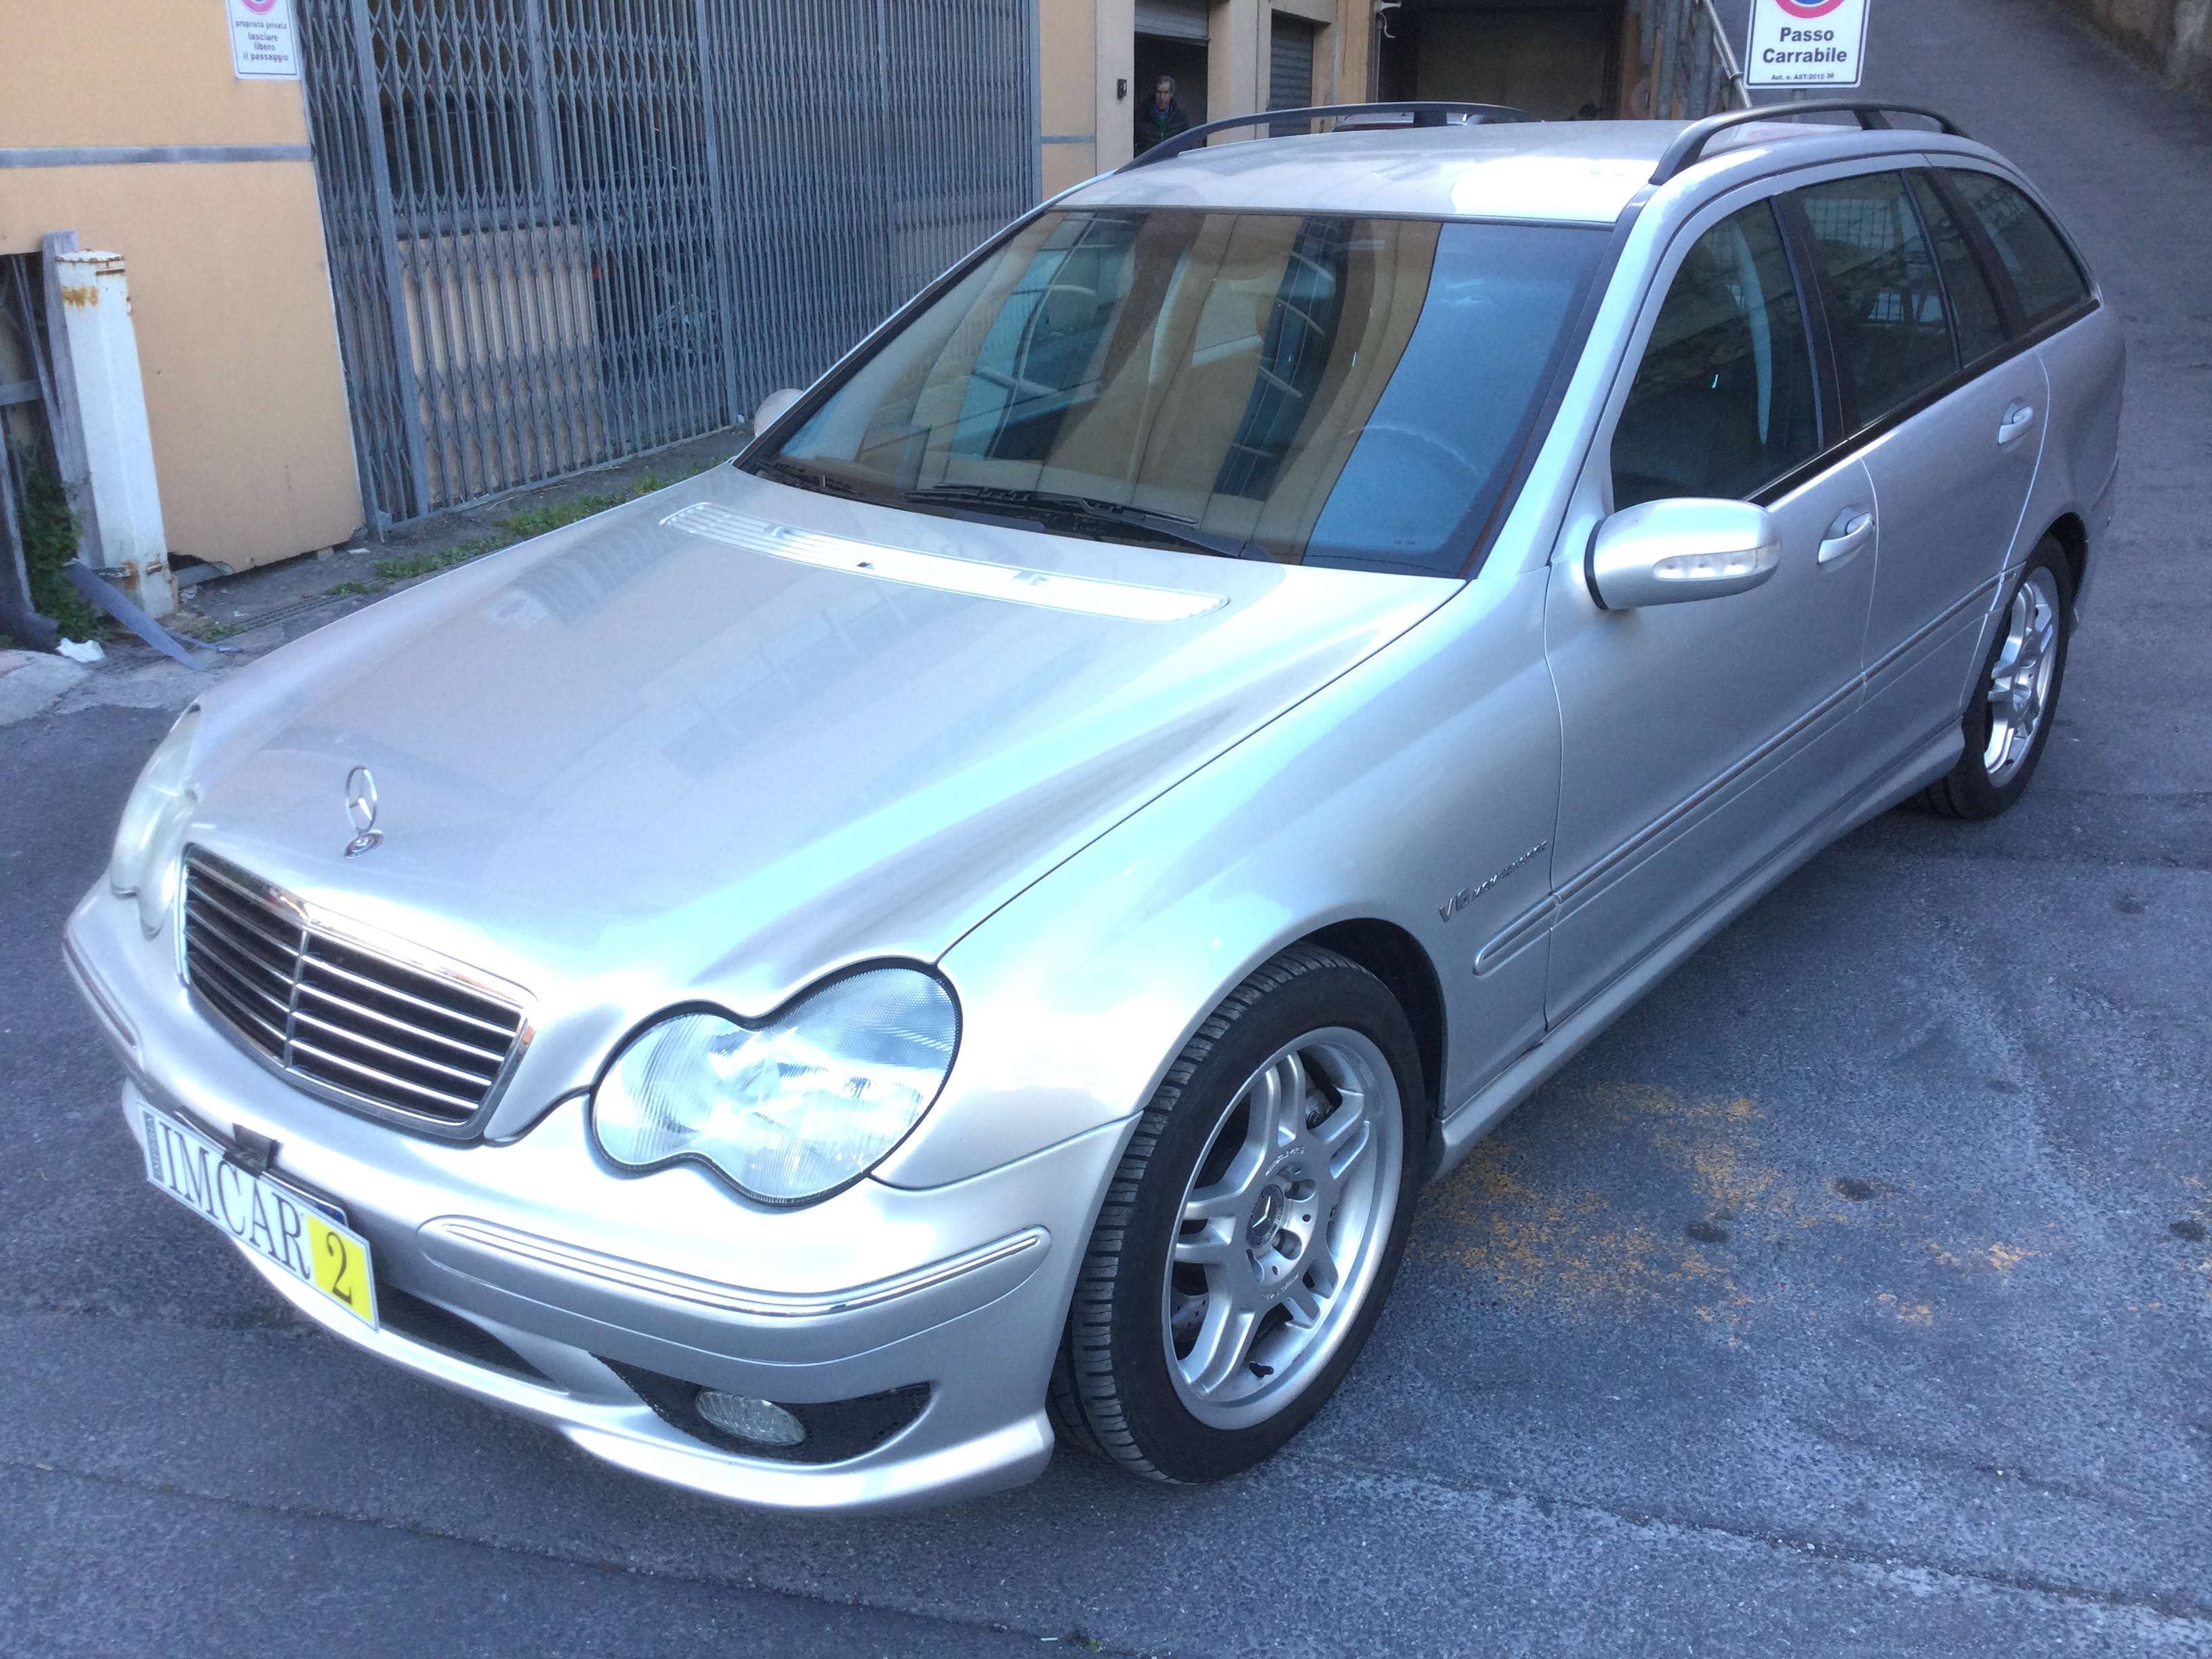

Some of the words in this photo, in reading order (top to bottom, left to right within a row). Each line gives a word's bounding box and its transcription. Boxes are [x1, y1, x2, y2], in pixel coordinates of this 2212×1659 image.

[248, 32, 279, 41] lasciare
[1780, 26, 1835, 42] Passo
[254, 43, 276, 51] libero
[243, 52, 249, 60] il
[251, 54, 288, 63] passaggio
[1763, 47, 1847, 63] Carrabile
[159, 1122, 310, 1280] IMCAR
[326, 1231, 353, 1307] 2
